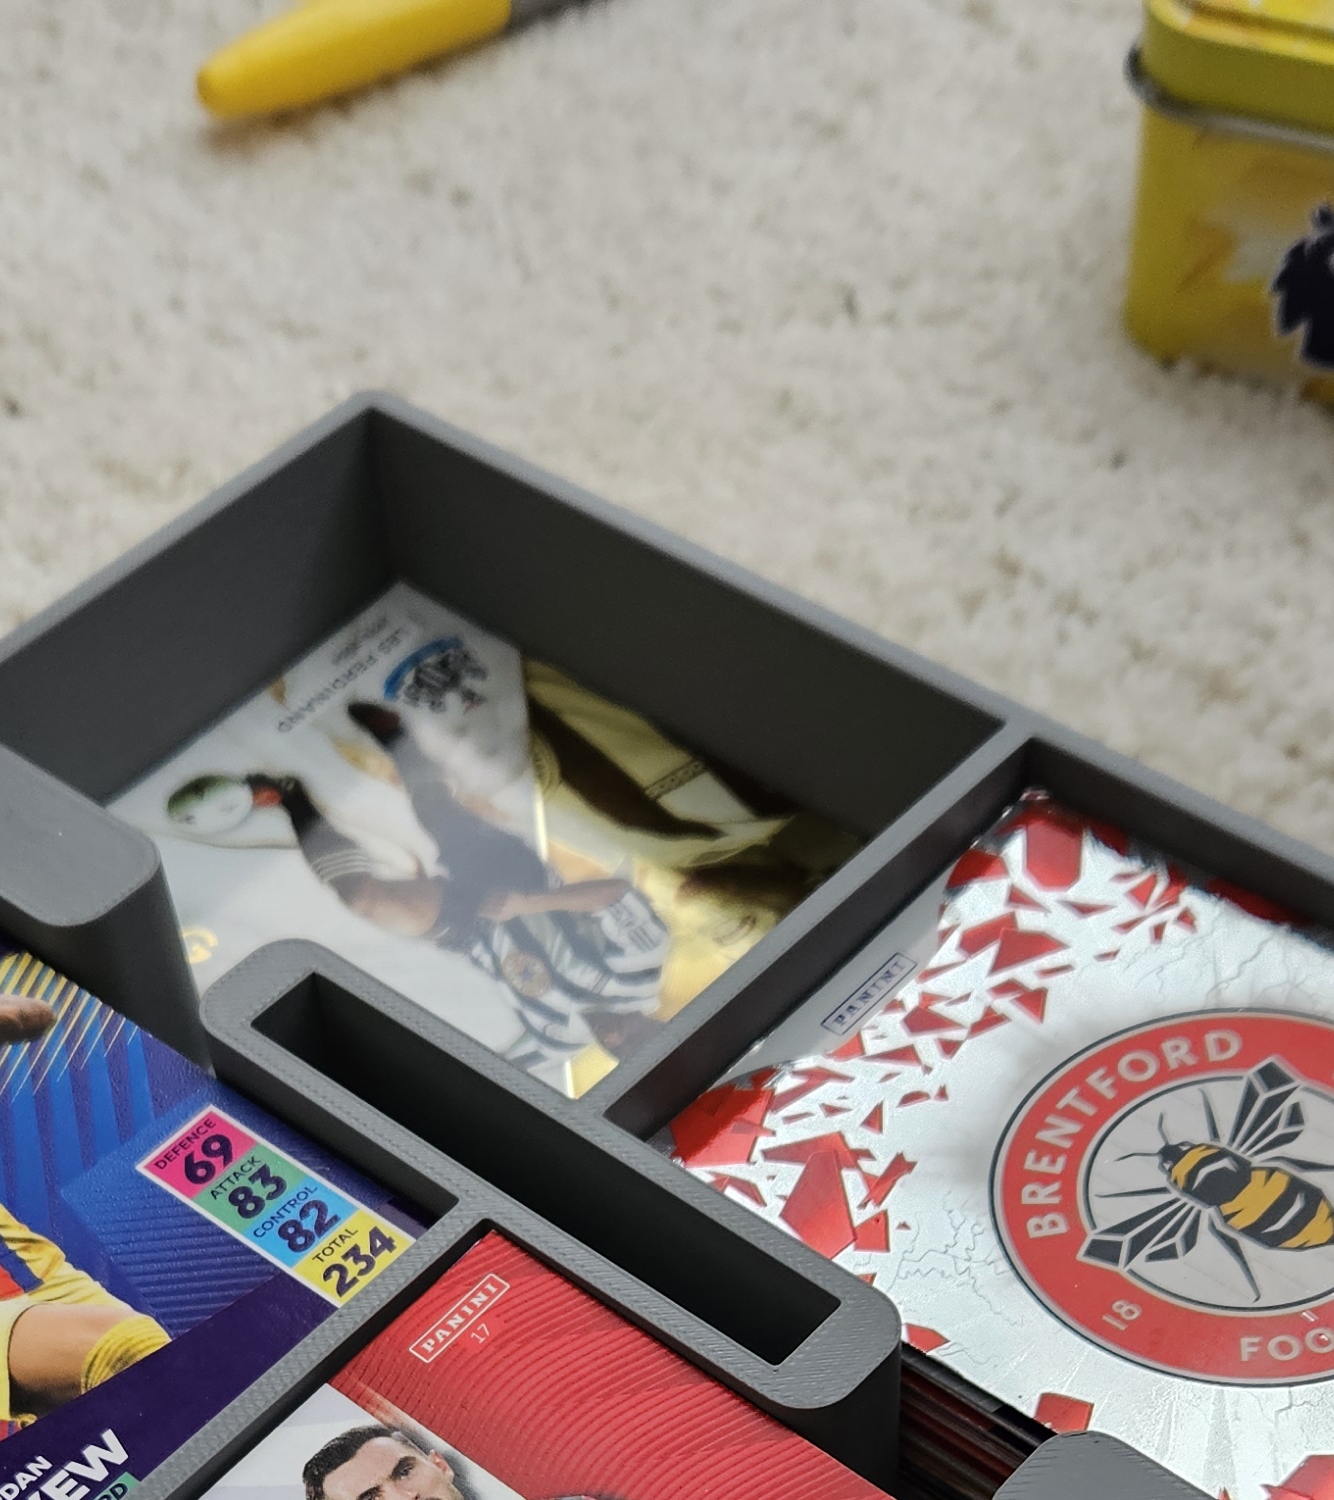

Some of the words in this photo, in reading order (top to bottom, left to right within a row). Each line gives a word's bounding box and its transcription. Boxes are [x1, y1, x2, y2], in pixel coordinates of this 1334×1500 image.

[832, 960, 907, 1027] PANINI
[154, 1118, 217, 1171] DEFENCE
[183, 1133, 233, 1184] 69
[1021, 1028, 1245, 1240] BRENTFORD
[210, 1155, 262, 1201] ATTACK
[227, 1164, 288, 1220] 83
[253, 1185, 318, 1239] CONTROL
[277, 1199, 342, 1254] 82
[311, 1226, 359, 1265] TOTAL
[322, 1226, 397, 1298] 234
[417, 1280, 500, 1355] PANINI
[470, 1322, 492, 1345] 17
[1101, 1298, 1144, 1332] 18
